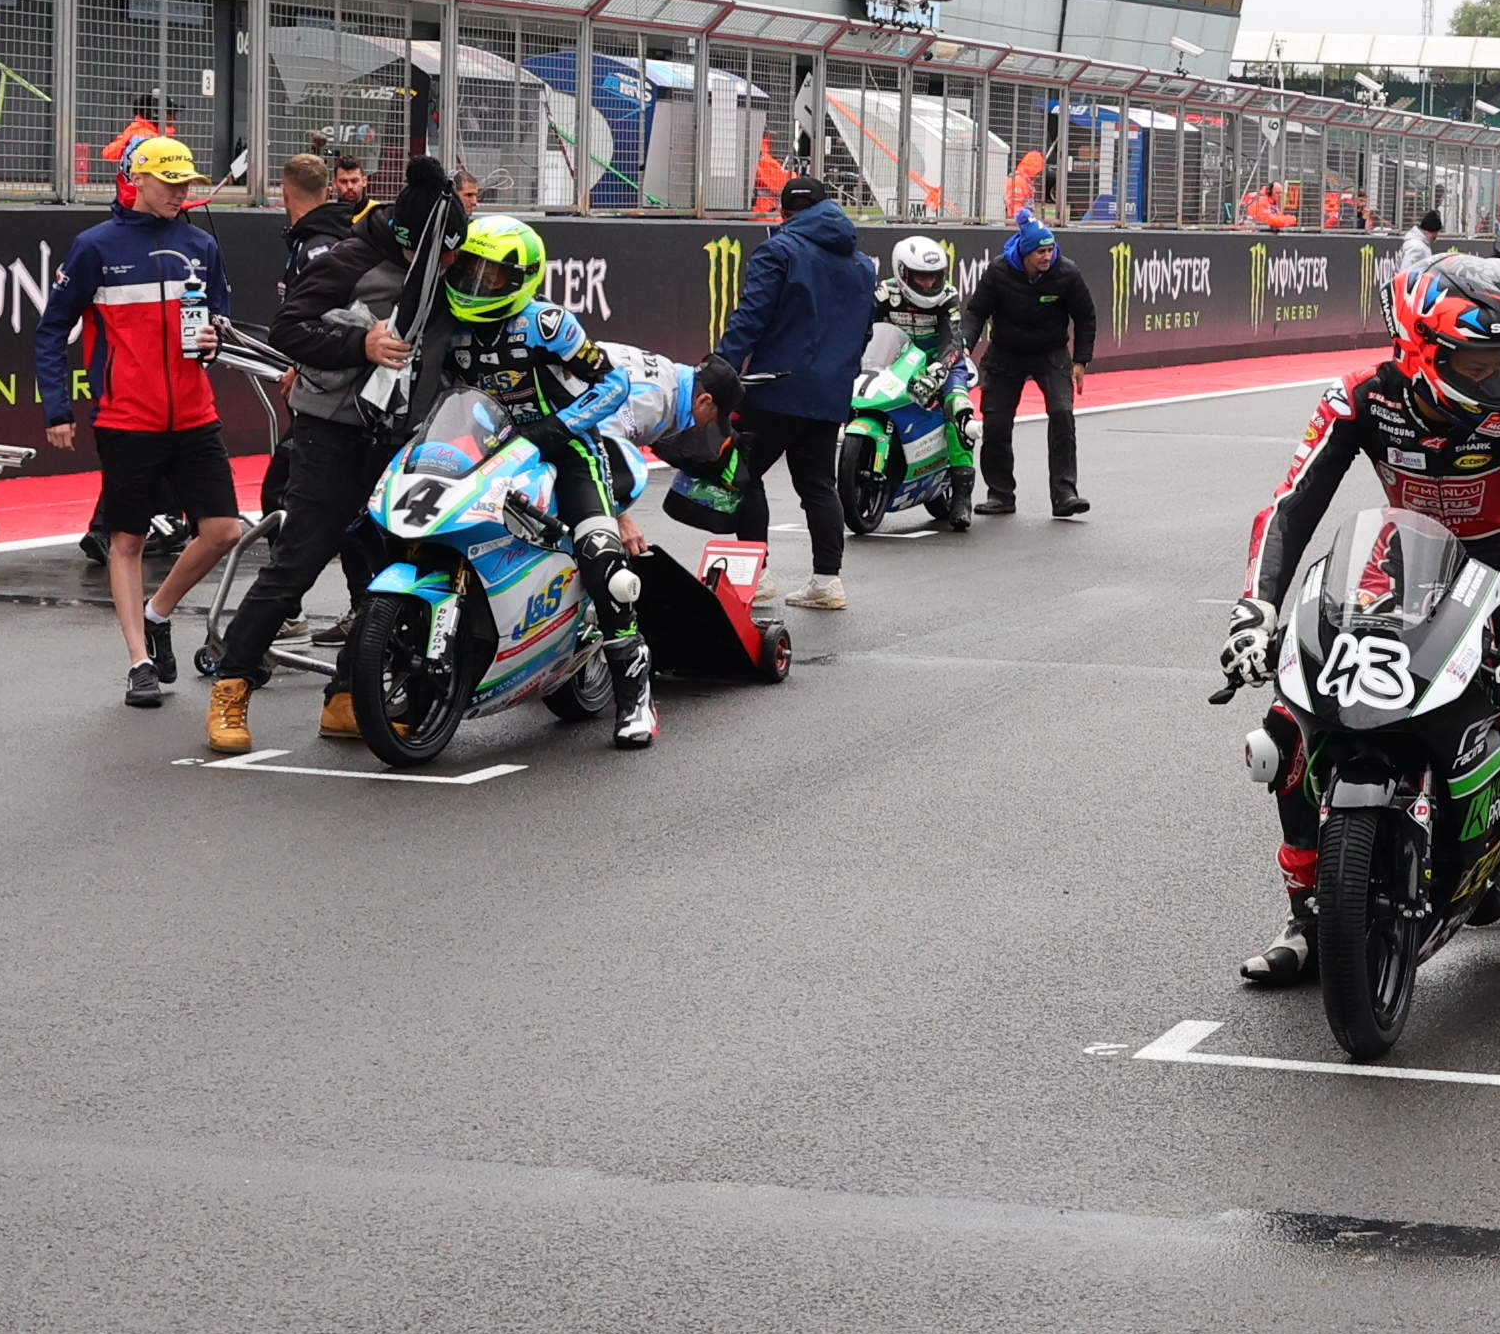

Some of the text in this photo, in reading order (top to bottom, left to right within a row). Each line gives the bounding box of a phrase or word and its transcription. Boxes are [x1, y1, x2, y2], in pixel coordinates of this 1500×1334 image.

[321, 124, 356, 143] elf
[1133, 248, 1213, 305] MONSTER
[1267, 248, 1329, 298] MONSTER
[1144, 310, 1201, 332] ENERGY
[1275, 304, 1321, 322] ENERGY
[1380, 289, 1394, 337] SHARK
[857, 370, 879, 398] 7
[1378, 422, 1415, 438] SAMSUNG
[1454, 442, 1491, 452] SHARK
[392, 476, 455, 528] 4
[1419, 483, 1483, 497] MONLAU
[471, 501, 497, 514] J&S
[1412, 498, 1473, 509] MOTUL
[511, 572, 565, 640] J&S
[431, 607, 448, 651] DUNLOP
[1317, 633, 1414, 710] 43
[1452, 743, 1486, 769] racing
